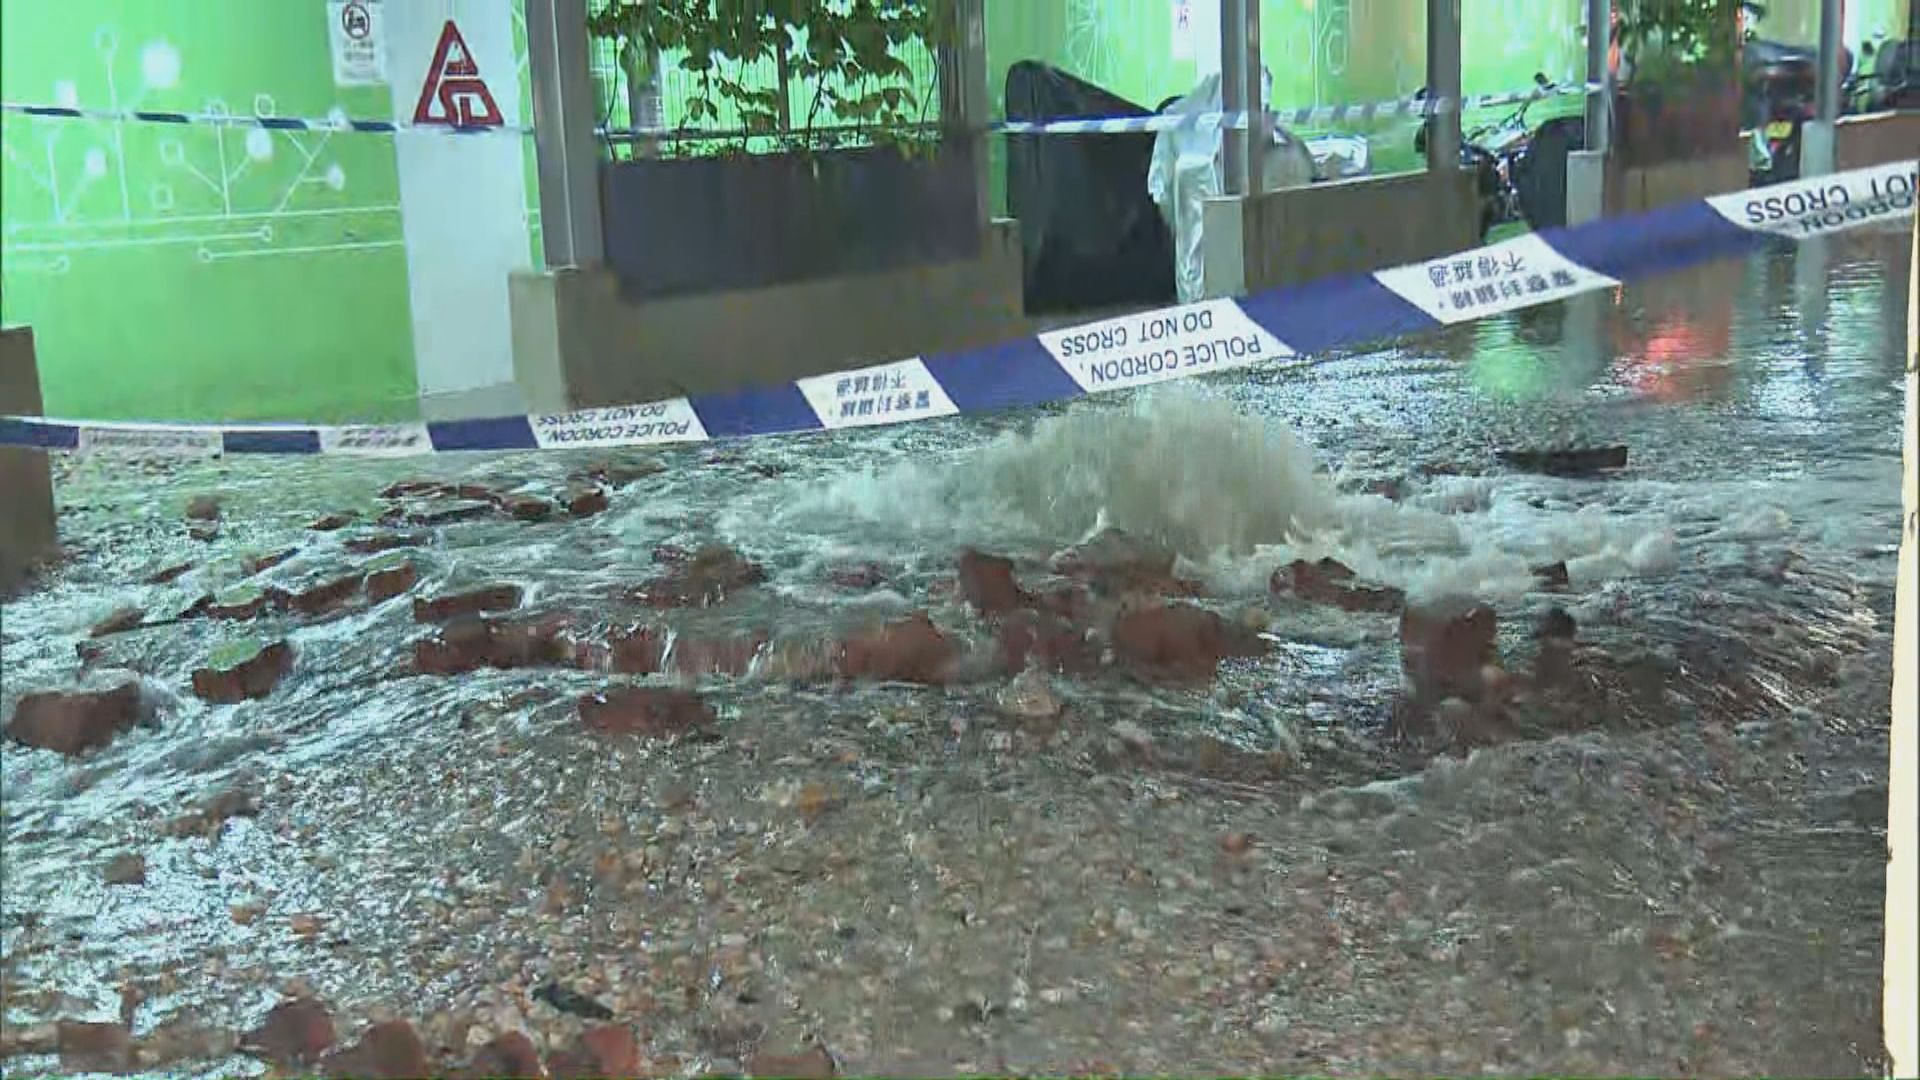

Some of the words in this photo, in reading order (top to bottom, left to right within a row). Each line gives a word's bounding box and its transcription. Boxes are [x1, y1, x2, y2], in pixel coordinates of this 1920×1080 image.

[1745, 184, 1850, 224] CROSS
[1138, 317, 1178, 343] NOT
[1182, 310, 1213, 332] DO
[1060, 326, 1128, 357] CROSS
[1183, 334, 1262, 367] POLICE
[599, 407, 639, 421] NOT
[639, 404, 667, 417] DO
[624, 419, 690, 438] POLICE
